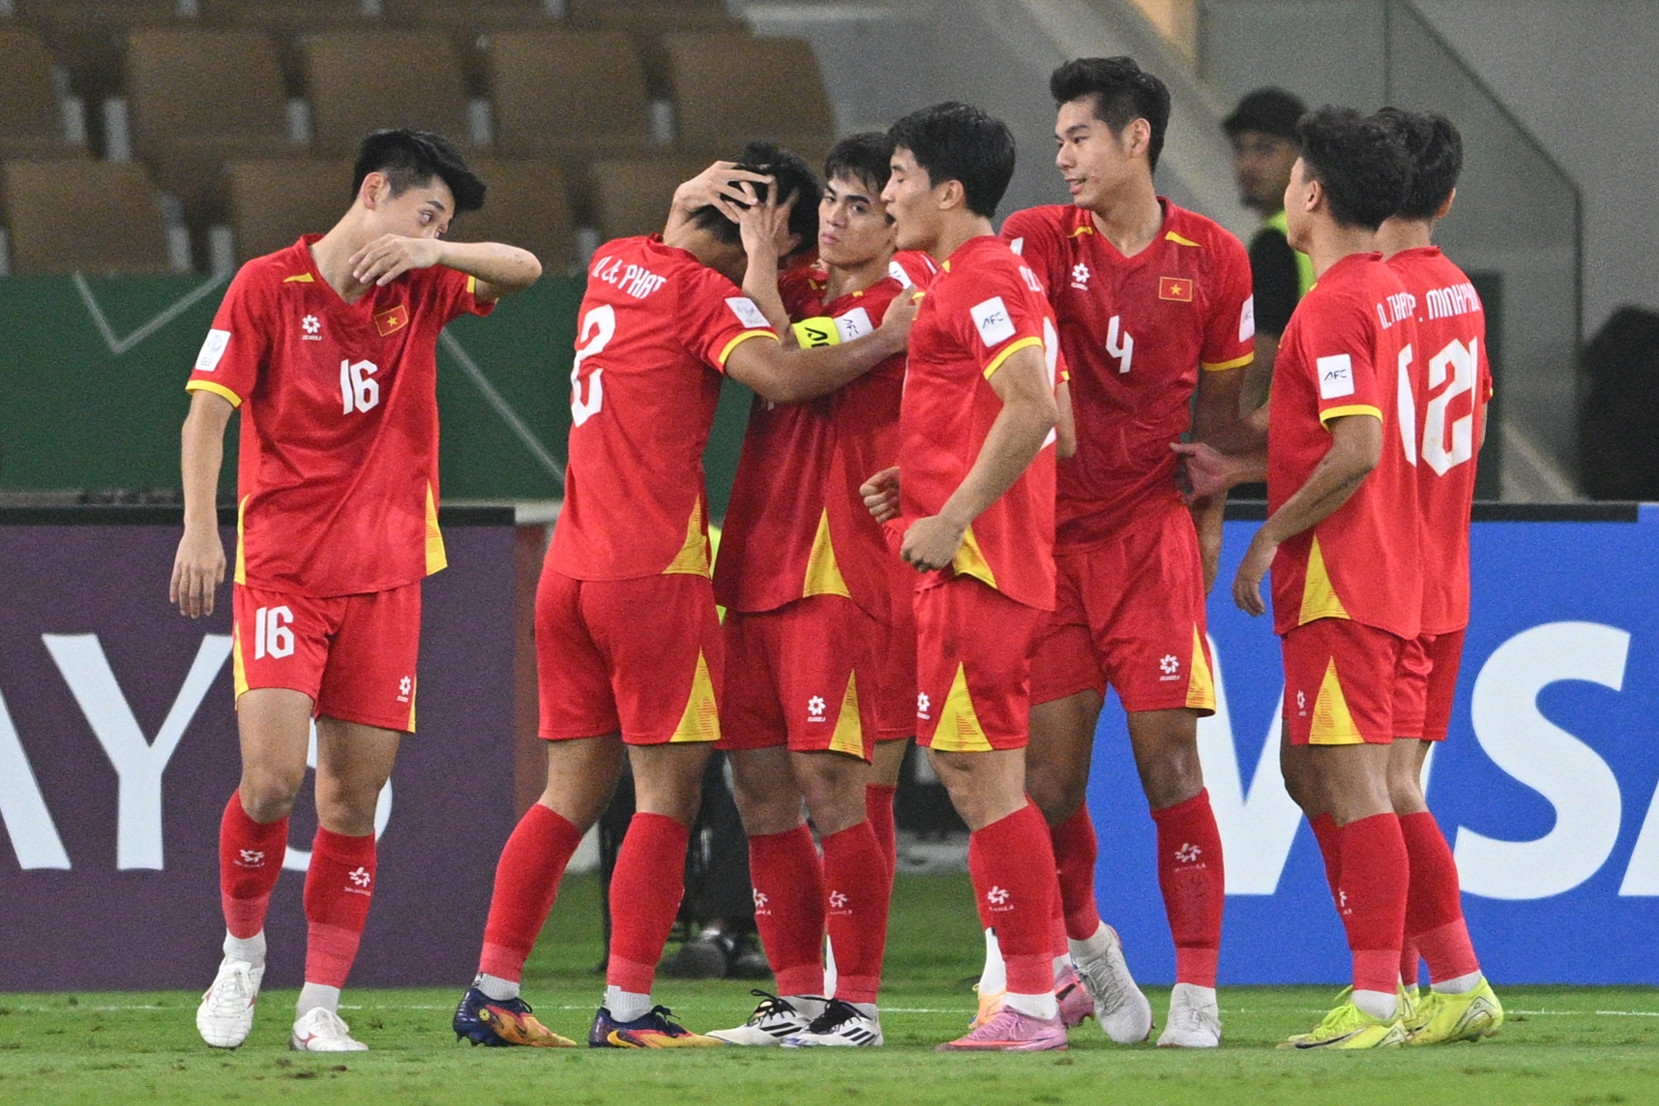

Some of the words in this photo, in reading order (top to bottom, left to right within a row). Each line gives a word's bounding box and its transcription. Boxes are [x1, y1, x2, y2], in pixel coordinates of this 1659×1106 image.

[981, 311, 1005, 330] AFC
[1105, 315, 1134, 373] 4
[340, 359, 380, 415] 16
[571, 303, 617, 428] 2
[1323, 368, 1348, 382] AFC
[254, 605, 295, 660] 16
